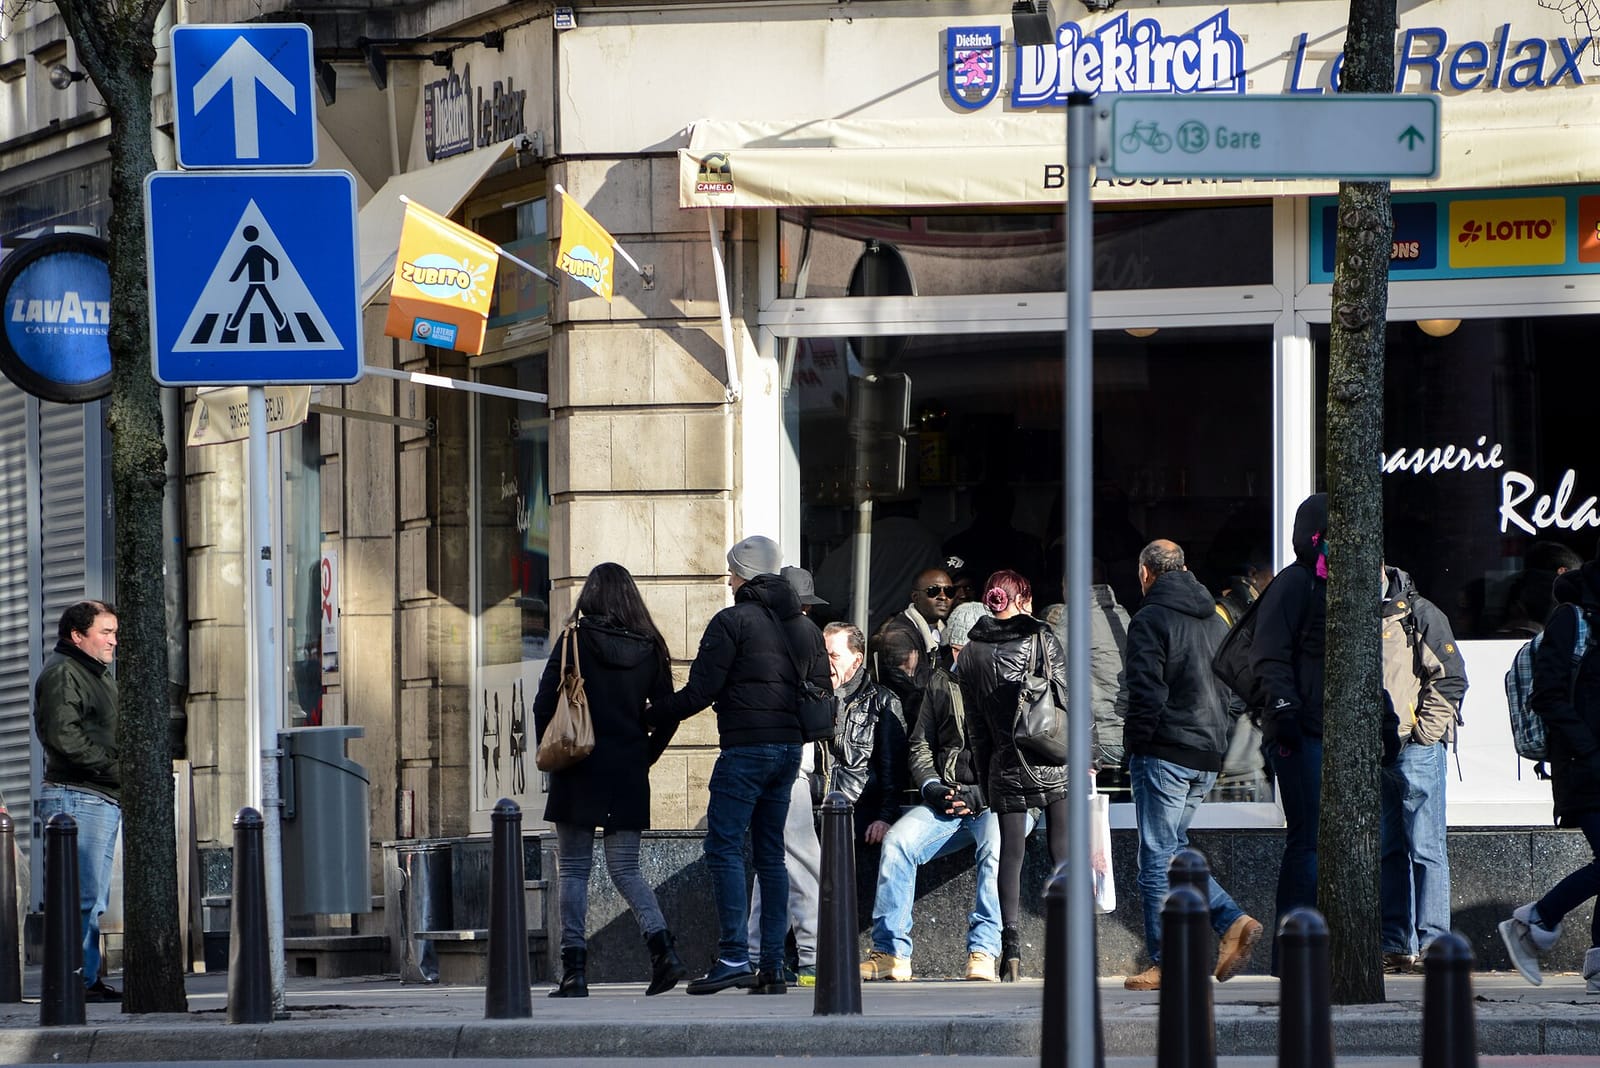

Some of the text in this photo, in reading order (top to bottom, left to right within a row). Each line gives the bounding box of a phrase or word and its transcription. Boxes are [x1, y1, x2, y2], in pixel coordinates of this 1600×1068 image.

[955, 33, 993, 47] Diekirch
[1017, 18, 1239, 100] Diekirch
[1395, 23, 1595, 93] Relax
[1180, 126, 1261, 149] 13 Gare
[697, 183, 733, 191] CAMELO
[1486, 219, 1552, 241] LOTTO
[402, 261, 471, 290] ZUBITO
[560, 251, 601, 282] ZUBITO
[12, 291, 110, 325] LAVAZZ
[63, 327, 108, 336] ESPRESS
[1499, 468, 1600, 536] Rela
